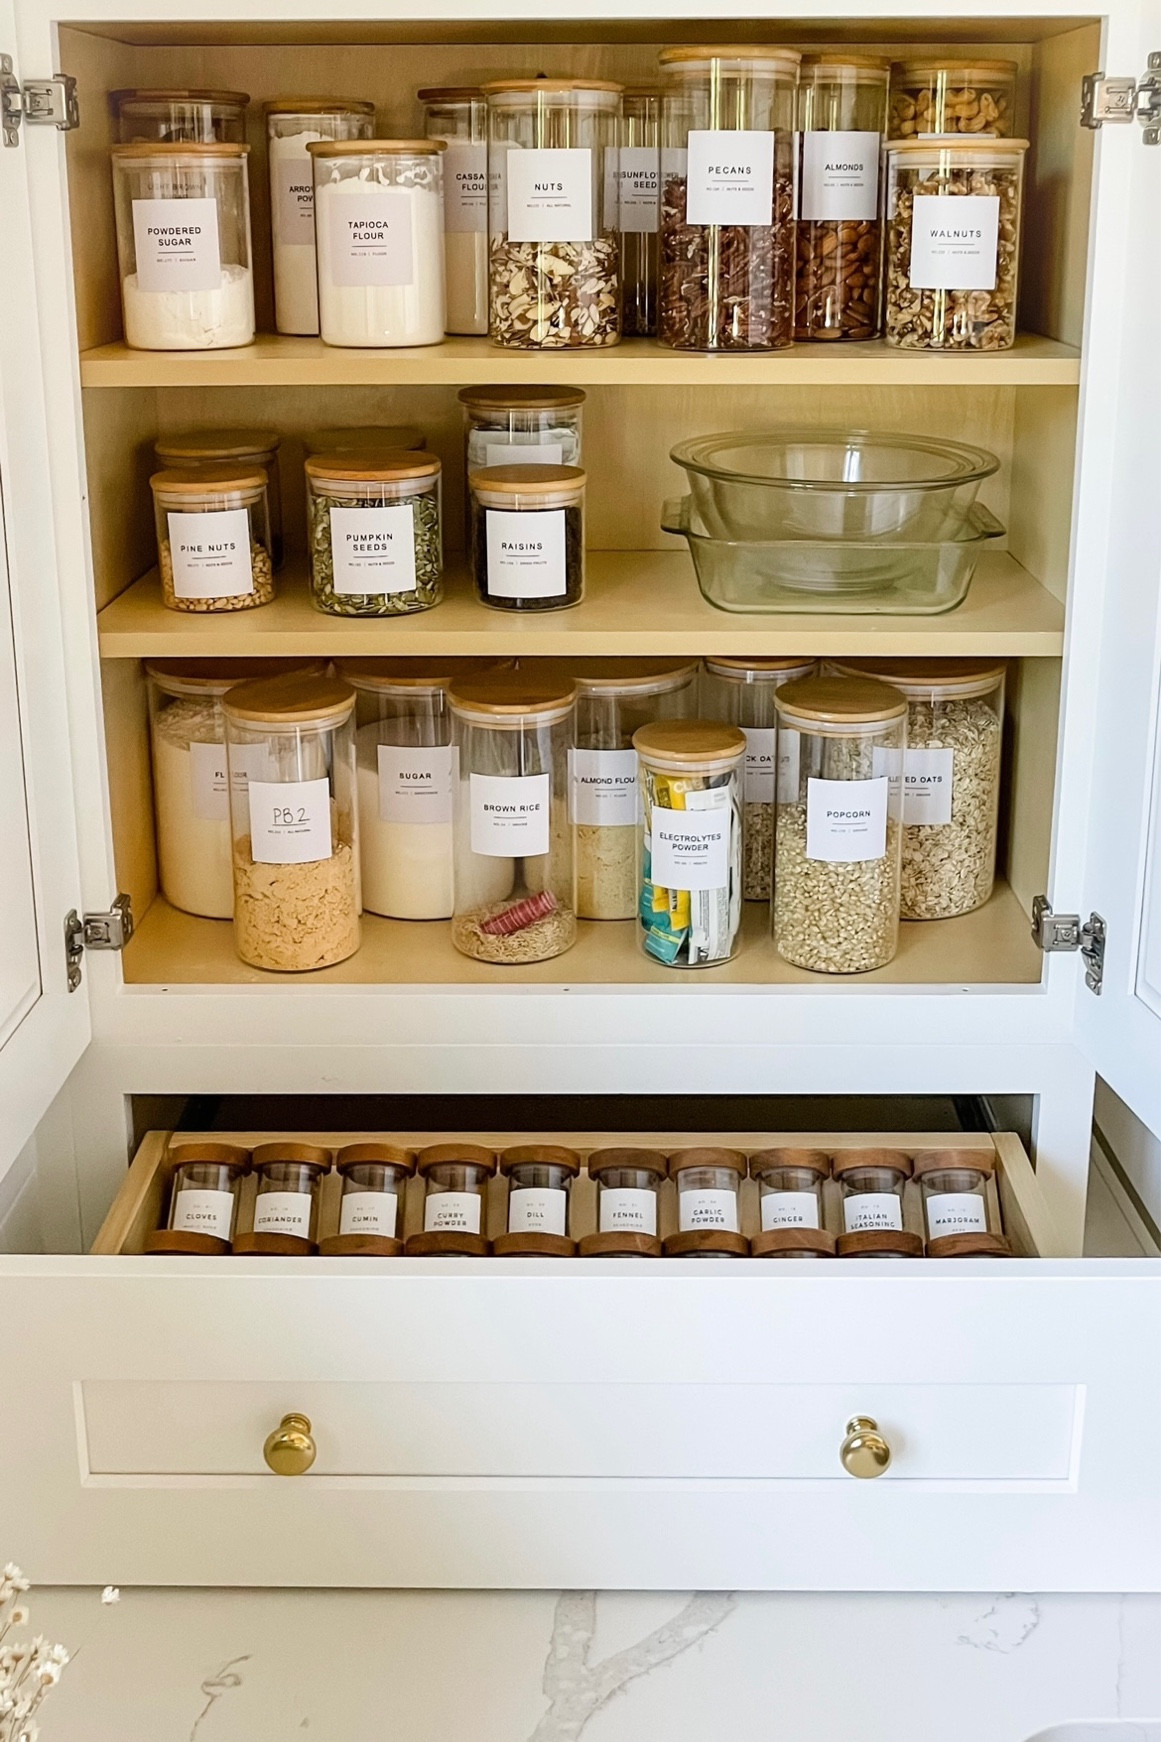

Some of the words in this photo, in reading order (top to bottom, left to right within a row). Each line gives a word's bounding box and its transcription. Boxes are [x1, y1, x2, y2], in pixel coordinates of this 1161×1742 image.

[708, 166, 751, 174] PECANS
[825, 163, 864, 171] ALMONDS
[534, 182, 563, 191] NUTS
[348, 221, 389, 229] TAPIOCA
[147, 226, 202, 235] POWDERED
[930, 230, 982, 238] WALNUTS
[352, 232, 384, 240] FLOUR
[158, 238, 192, 246] SUGAR
[346, 533, 393, 541] PUMPKIN
[180, 544, 203, 552] PINE
[208, 542, 236, 551] NUTS
[352, 543, 387, 551] SEEDS
[501, 542, 543, 550] RAISINS
[399, 772, 432, 780] SUGAR
[581, 776, 613, 784] ALMOND
[483, 804, 517, 813] BROWN
[519, 803, 541, 812] RICE
[826, 810, 871, 818] POPCORN
[659, 832, 722, 843] ELECTROLYTES
[672, 843, 709, 851] POWDER
[185, 1213, 217, 1221] CLOVES
[258, 1216, 302, 1224] CORIANDER
[773, 1215, 803, 1223] GINGER
[855, 1213, 888, 1221] ITALIAN
[935, 1216, 980, 1224] MARJORAM
[850, 1221, 895, 1230] SEASONING
